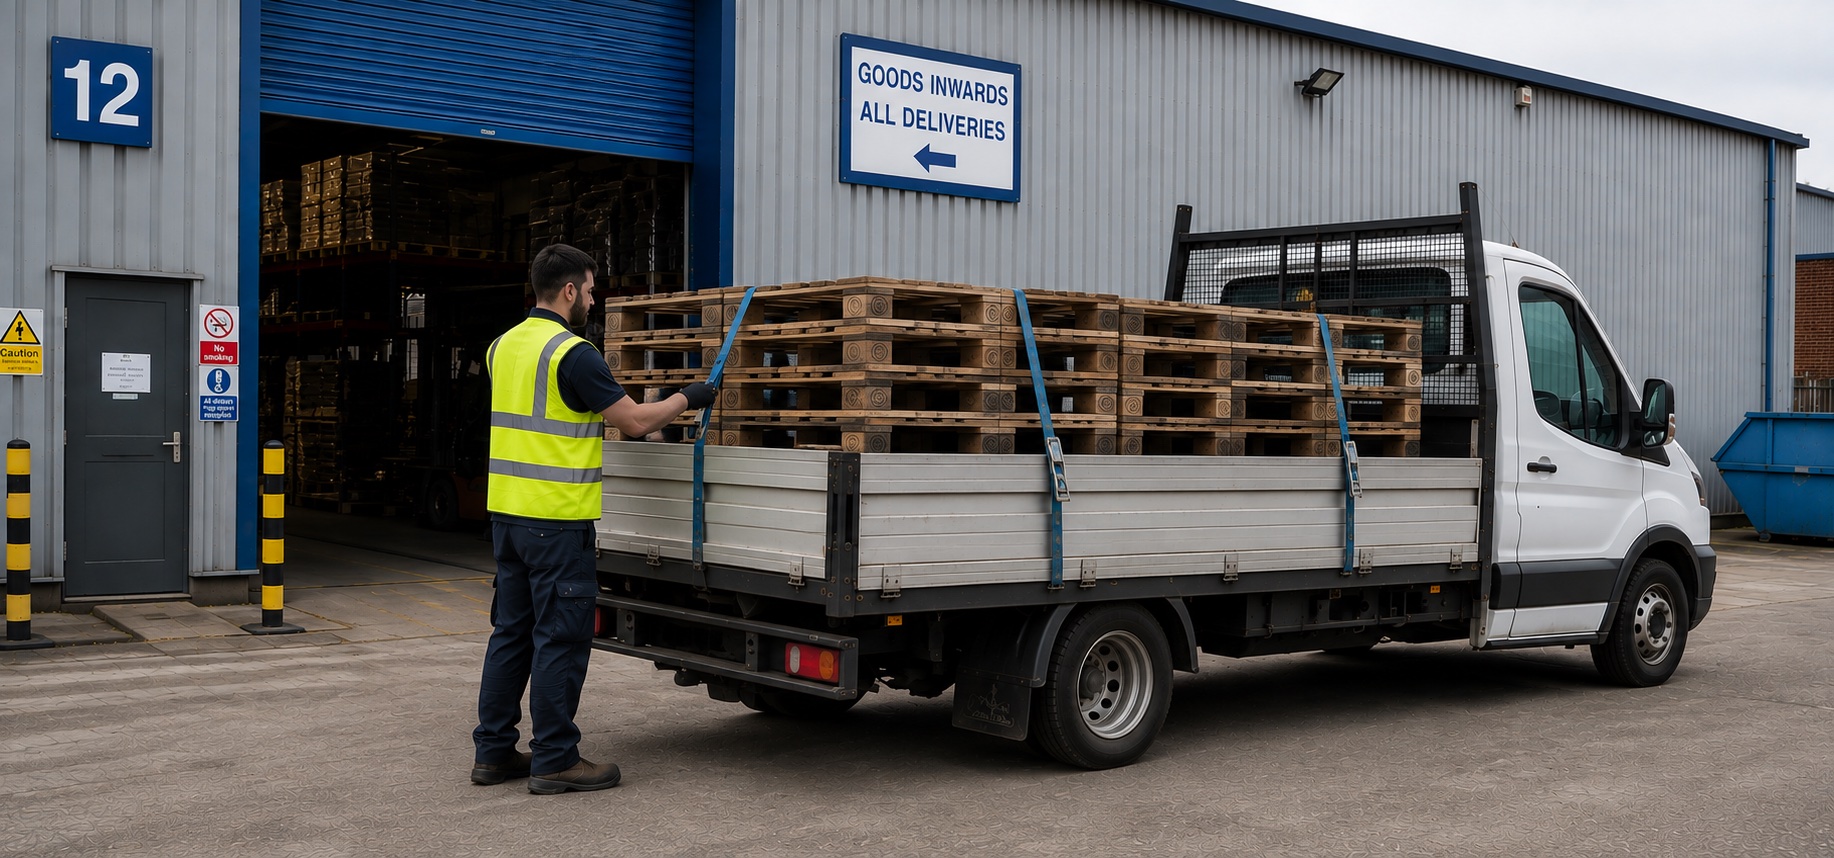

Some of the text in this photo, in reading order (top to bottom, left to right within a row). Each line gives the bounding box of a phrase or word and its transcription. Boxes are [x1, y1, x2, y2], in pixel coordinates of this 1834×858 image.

[64, 59, 139, 127] 12
[858, 62, 1008, 106] GOODS INWARDS
[860, 101, 1005, 141] ALL DELIVERIES
[0, 348, 39, 357] Caution
[213, 344, 225, 352] No
